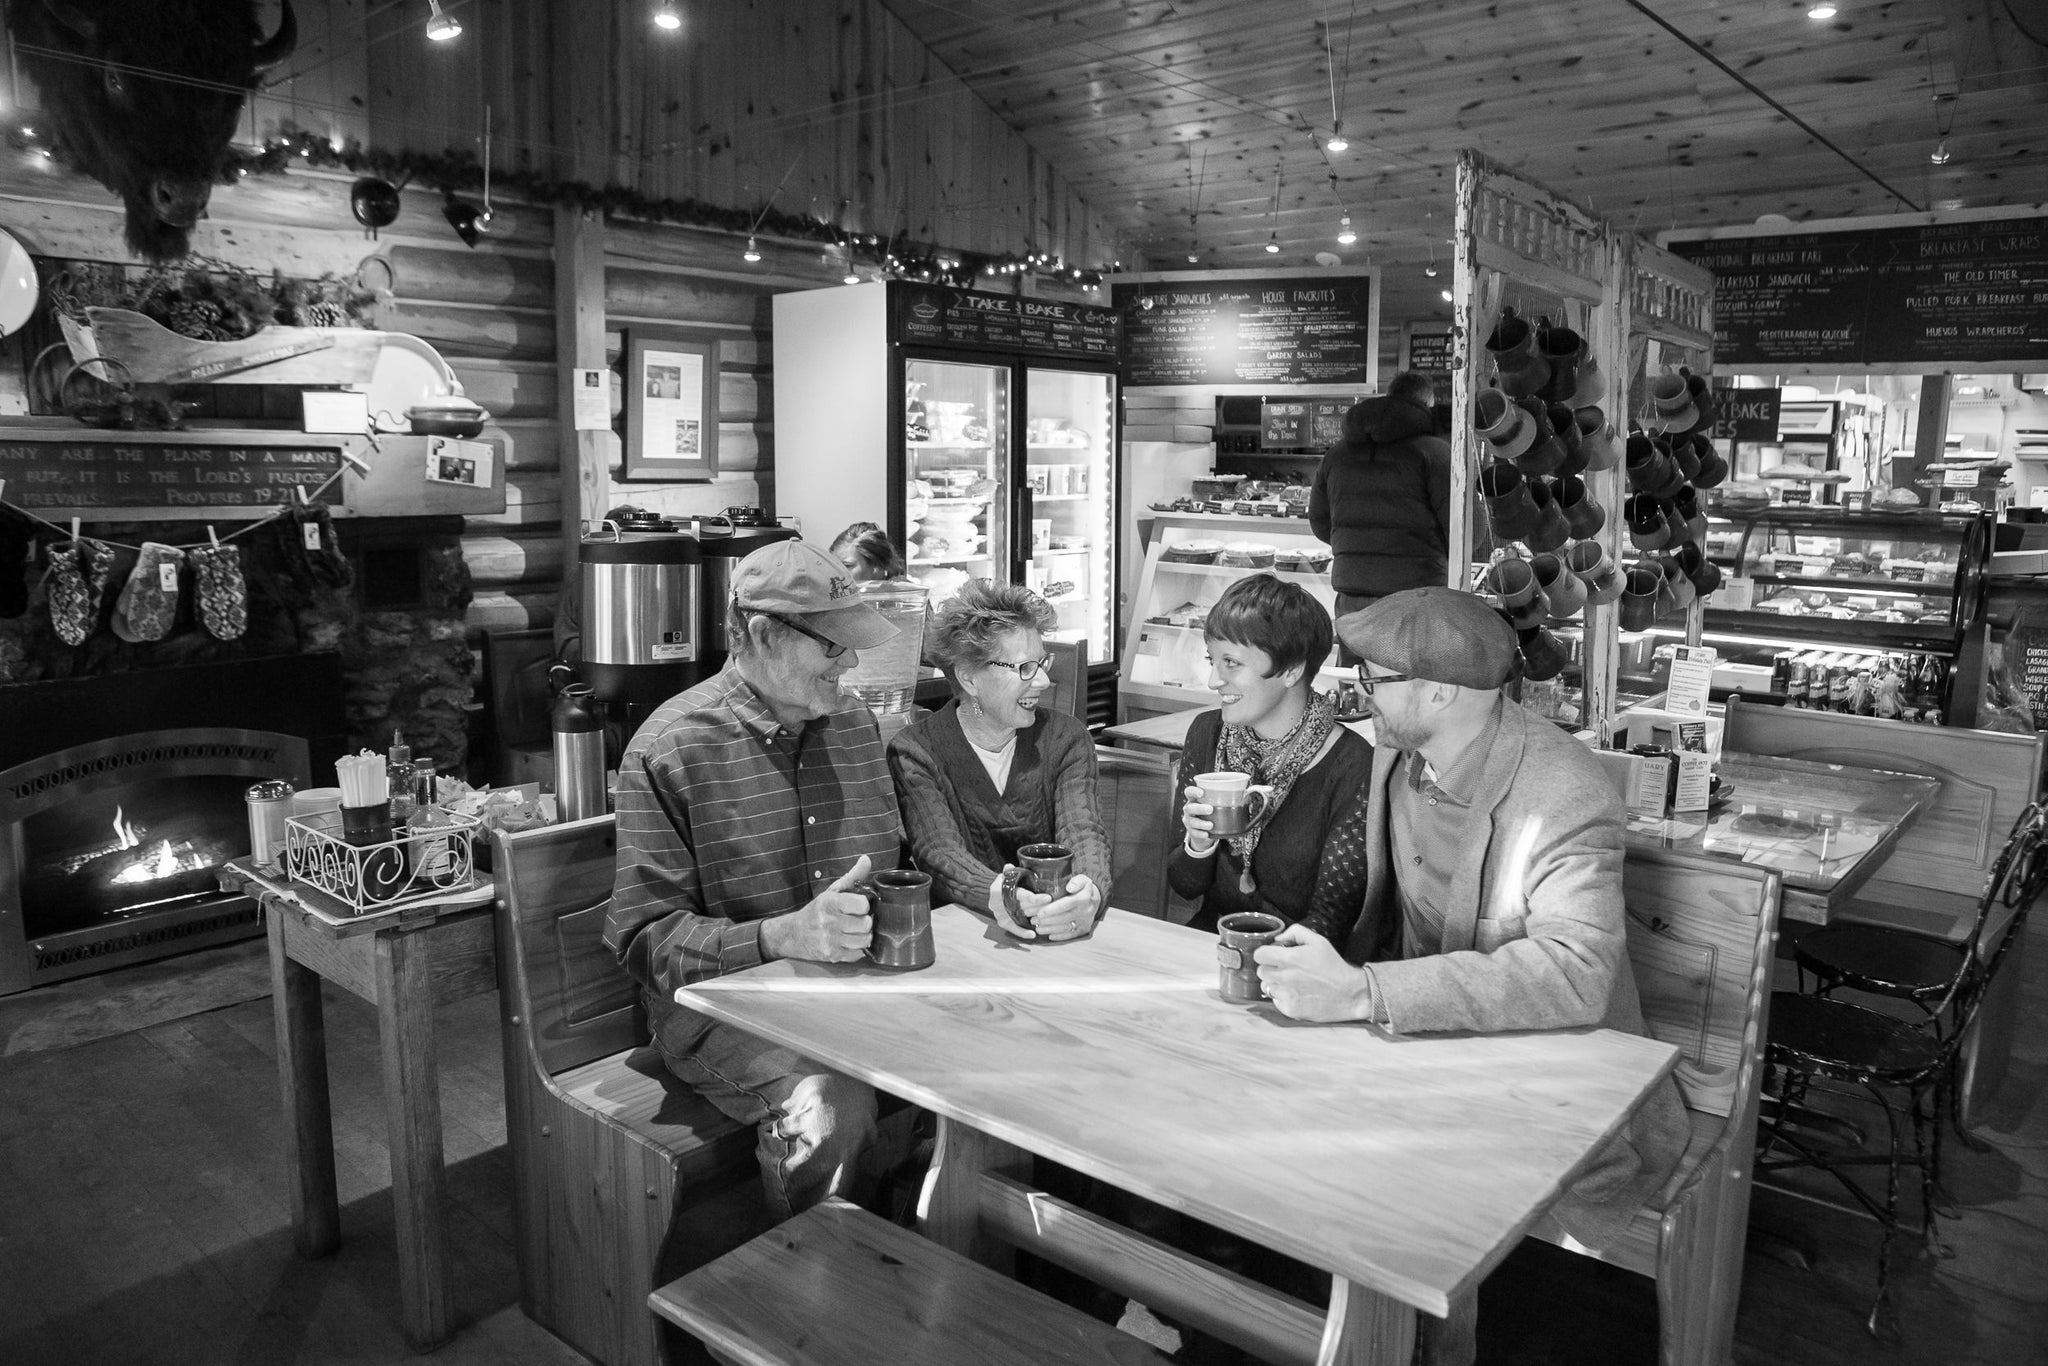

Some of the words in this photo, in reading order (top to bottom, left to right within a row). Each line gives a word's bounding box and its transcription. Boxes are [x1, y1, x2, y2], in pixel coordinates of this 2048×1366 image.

[1920, 238, 1986, 257] BREAKFAST
[1999, 235, 2041, 251] WRAPS
[1752, 251, 1795, 265] BREAKFAST
[1716, 274, 1760, 289] REAKFAST
[1768, 272, 1811, 287] SANDWICH
[1944, 271, 1960, 283] THE
[1965, 270, 1984, 281] OLD
[1988, 269, 2019, 281] TIMER
[1171, 293, 1212, 306] SANDWICHES
[1262, 291, 1285, 303] HOUSE
[1293, 289, 1335, 302] FAVORITES
[1906, 296, 1939, 308] PULLED
[1945, 295, 1970, 305] PORK
[1976, 294, 2026, 305] BREAKFAST
[967, 295, 1010, 312] TAKE
[1025, 303, 1065, 318] BAKE
[1758, 330, 1820, 341] MEDITERRANEAN
[1821, 329, 1850, 340] QUICHE
[1926, 326, 1958, 337] HUEVOS
[1966, 325, 2025, 336] WRAPCHEROS
[1266, 351, 1292, 360] GARDEN
[1296, 351, 1322, 359] SALADS
[190, 362, 226, 379] MERRY
[1731, 402, 1770, 420] BAKE
[61, 448, 95, 461] ARE
[115, 448, 144, 461] THE
[164, 450, 212, 463] PLANS
[230, 451, 247, 463] IN
[263, 452, 275, 463] A
[79, 471, 97, 483] IT
[117, 471, 131, 484] IS
[149, 471, 180, 484] THE
[267, 471, 329, 484] PURPOSE
[167, 488, 244, 504] PROVERBS
[2022, 683, 2043, 692] SOUP
